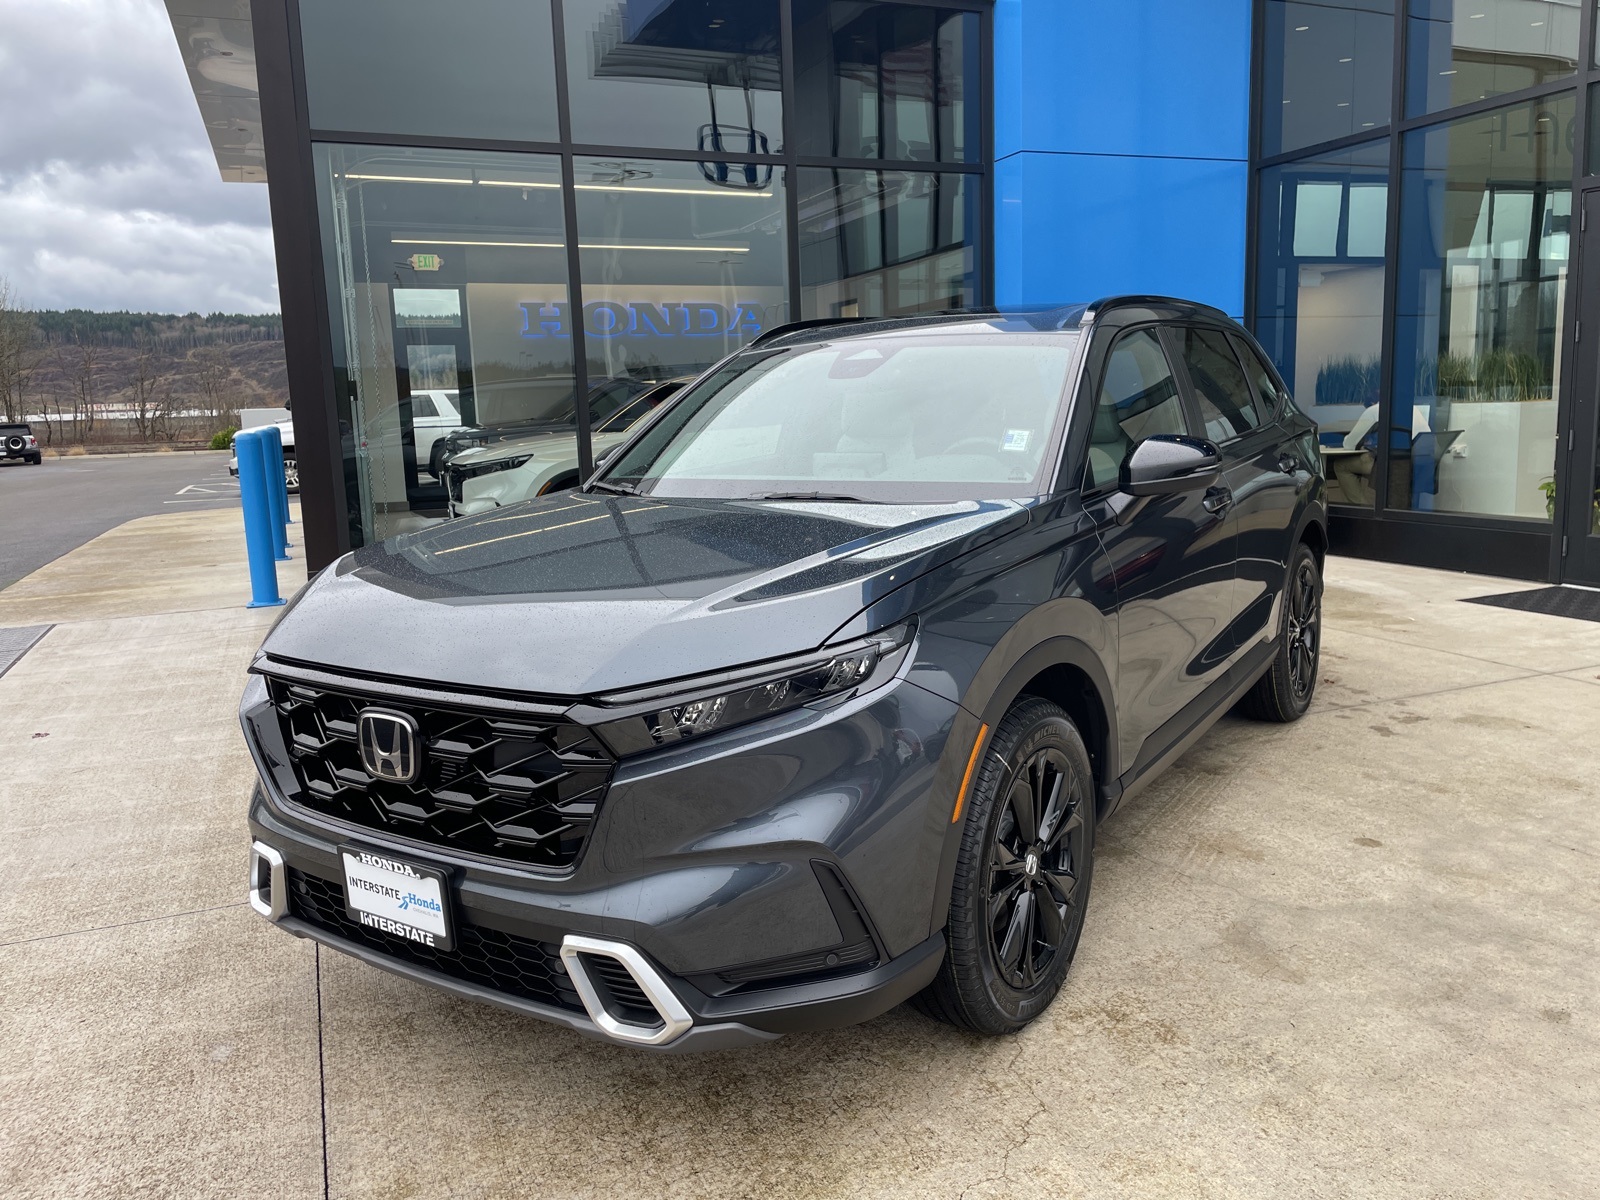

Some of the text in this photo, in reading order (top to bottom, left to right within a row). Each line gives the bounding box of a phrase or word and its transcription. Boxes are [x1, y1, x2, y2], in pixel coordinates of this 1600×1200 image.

[417, 255, 435, 268] EXIT
[519, 301, 768, 337] HONDA
[359, 853, 416, 878] HONDA
[348, 876, 442, 913] INTERSTATE Honda
[359, 911, 435, 947] INTERSTATE
